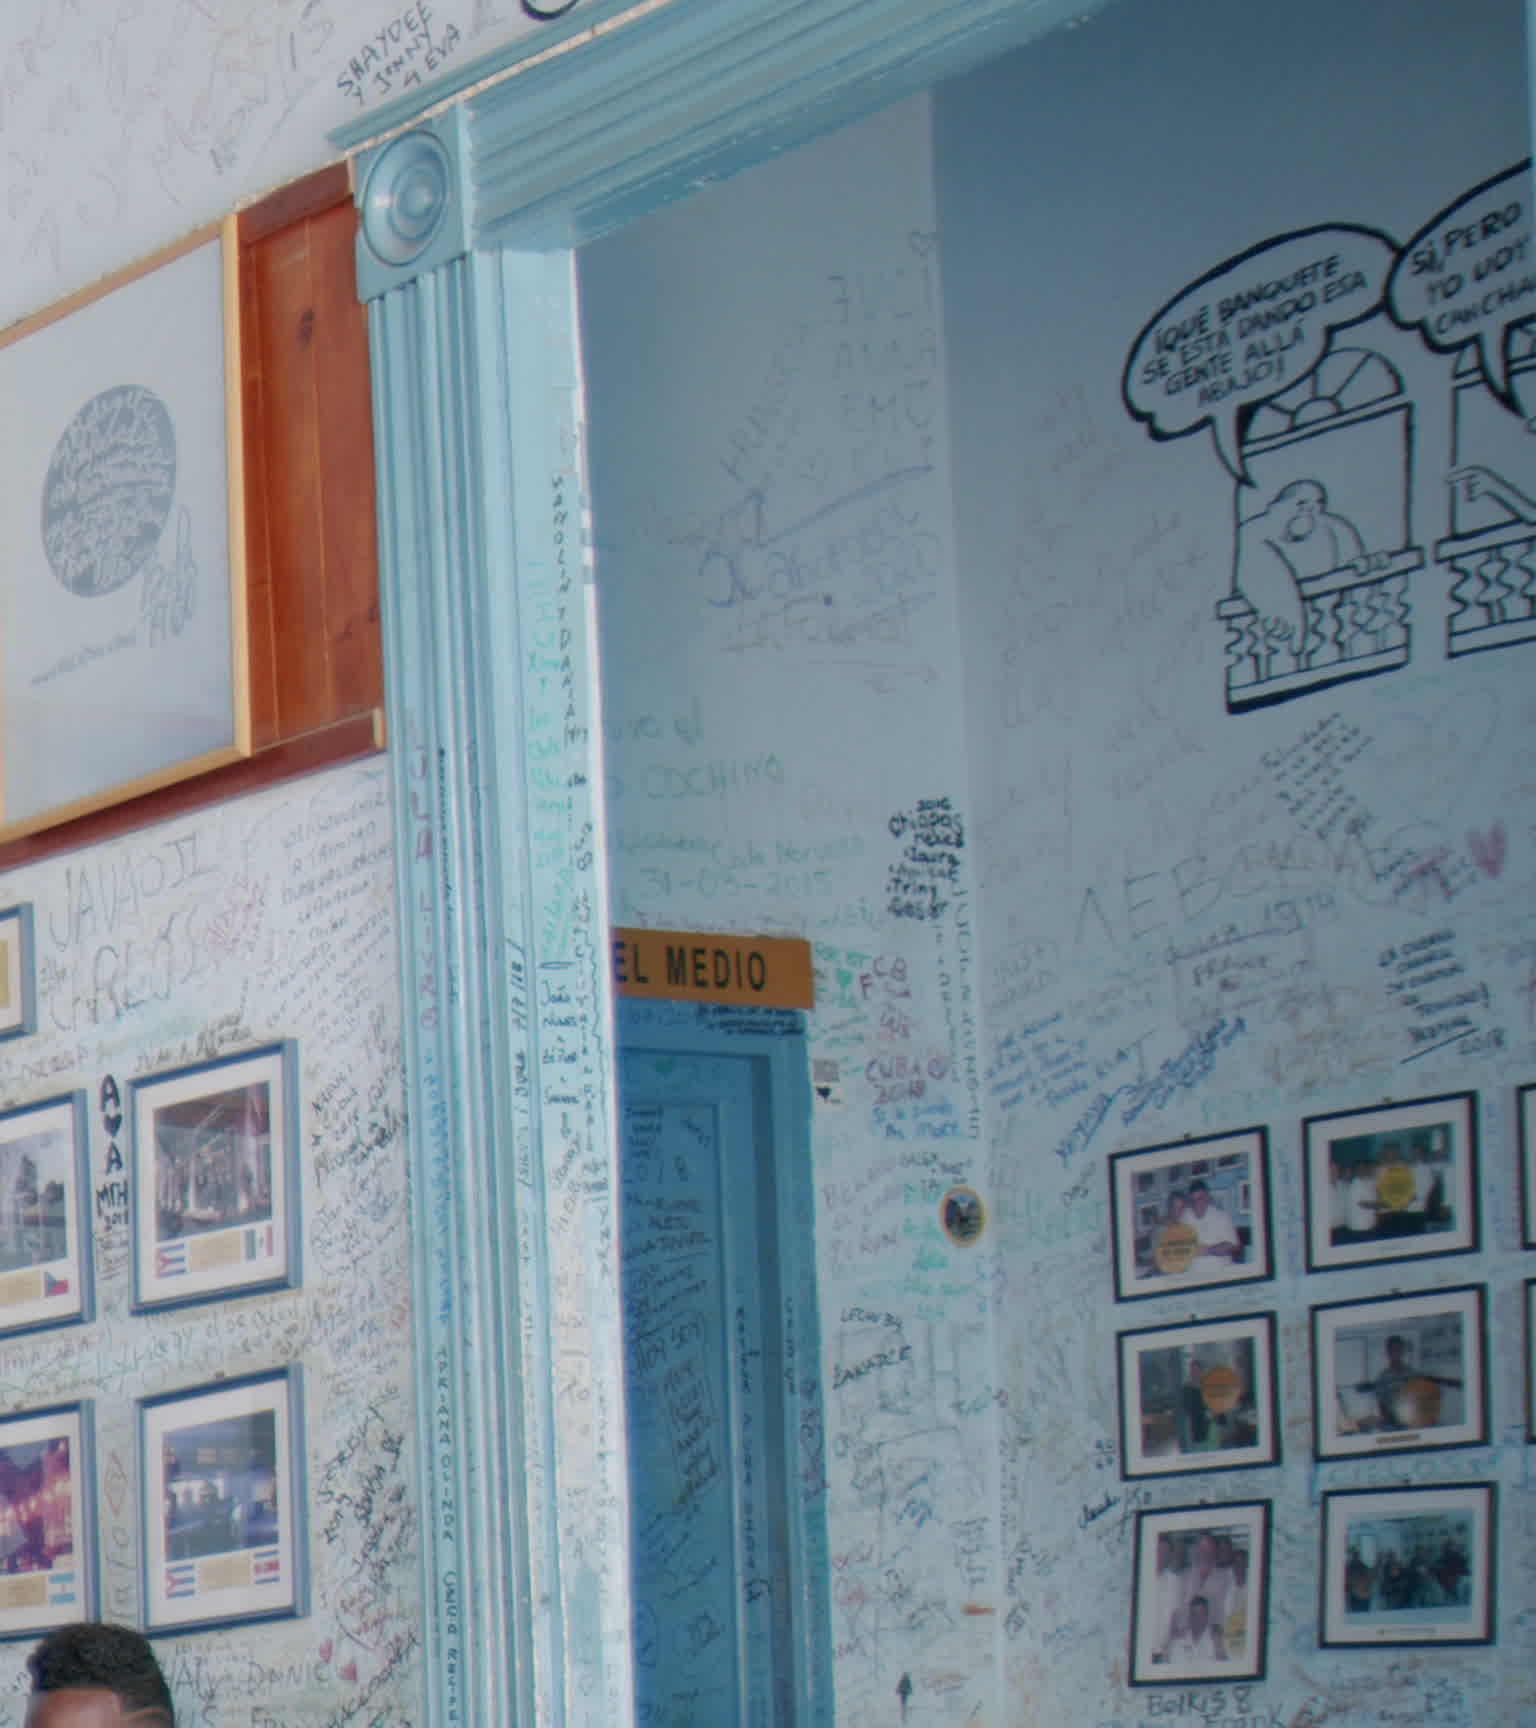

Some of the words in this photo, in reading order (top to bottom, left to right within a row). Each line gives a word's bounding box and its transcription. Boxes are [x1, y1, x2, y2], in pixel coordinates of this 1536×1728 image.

[1443, 201, 1523, 254] PERO
[1219, 254, 1341, 319] BANQUETE
[1141, 357, 1171, 385] SE
[1238, 294, 1318, 340] DANDO
[1324, 270, 1368, 305] ESA
[1165, 350, 1233, 396] GENTE
[666, 945, 767, 992] MEDIO
